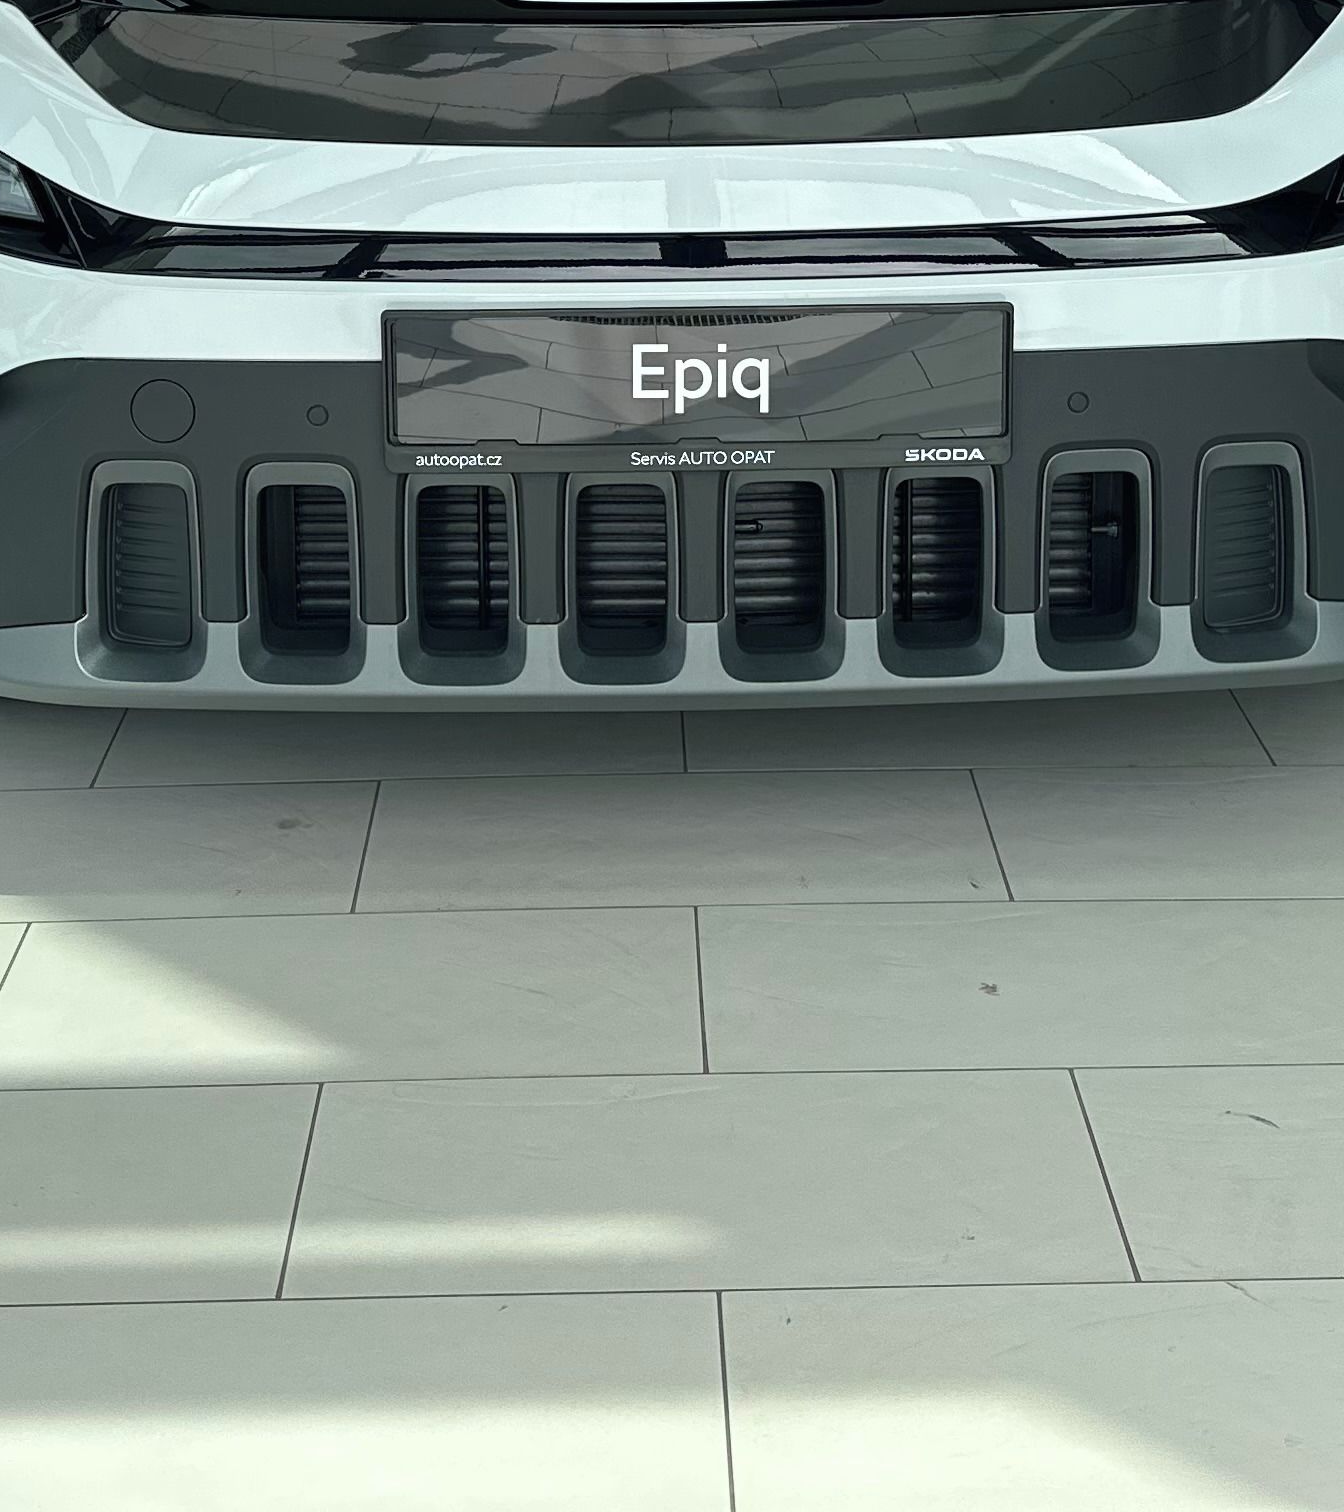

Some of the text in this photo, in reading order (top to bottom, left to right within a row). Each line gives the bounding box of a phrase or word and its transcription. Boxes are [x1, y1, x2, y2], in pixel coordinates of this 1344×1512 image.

[632, 343, 770, 414] Epiq
[416, 453, 503, 470] autoopat.cz
[630, 450, 776, 466] Servis AUTO OPAT
